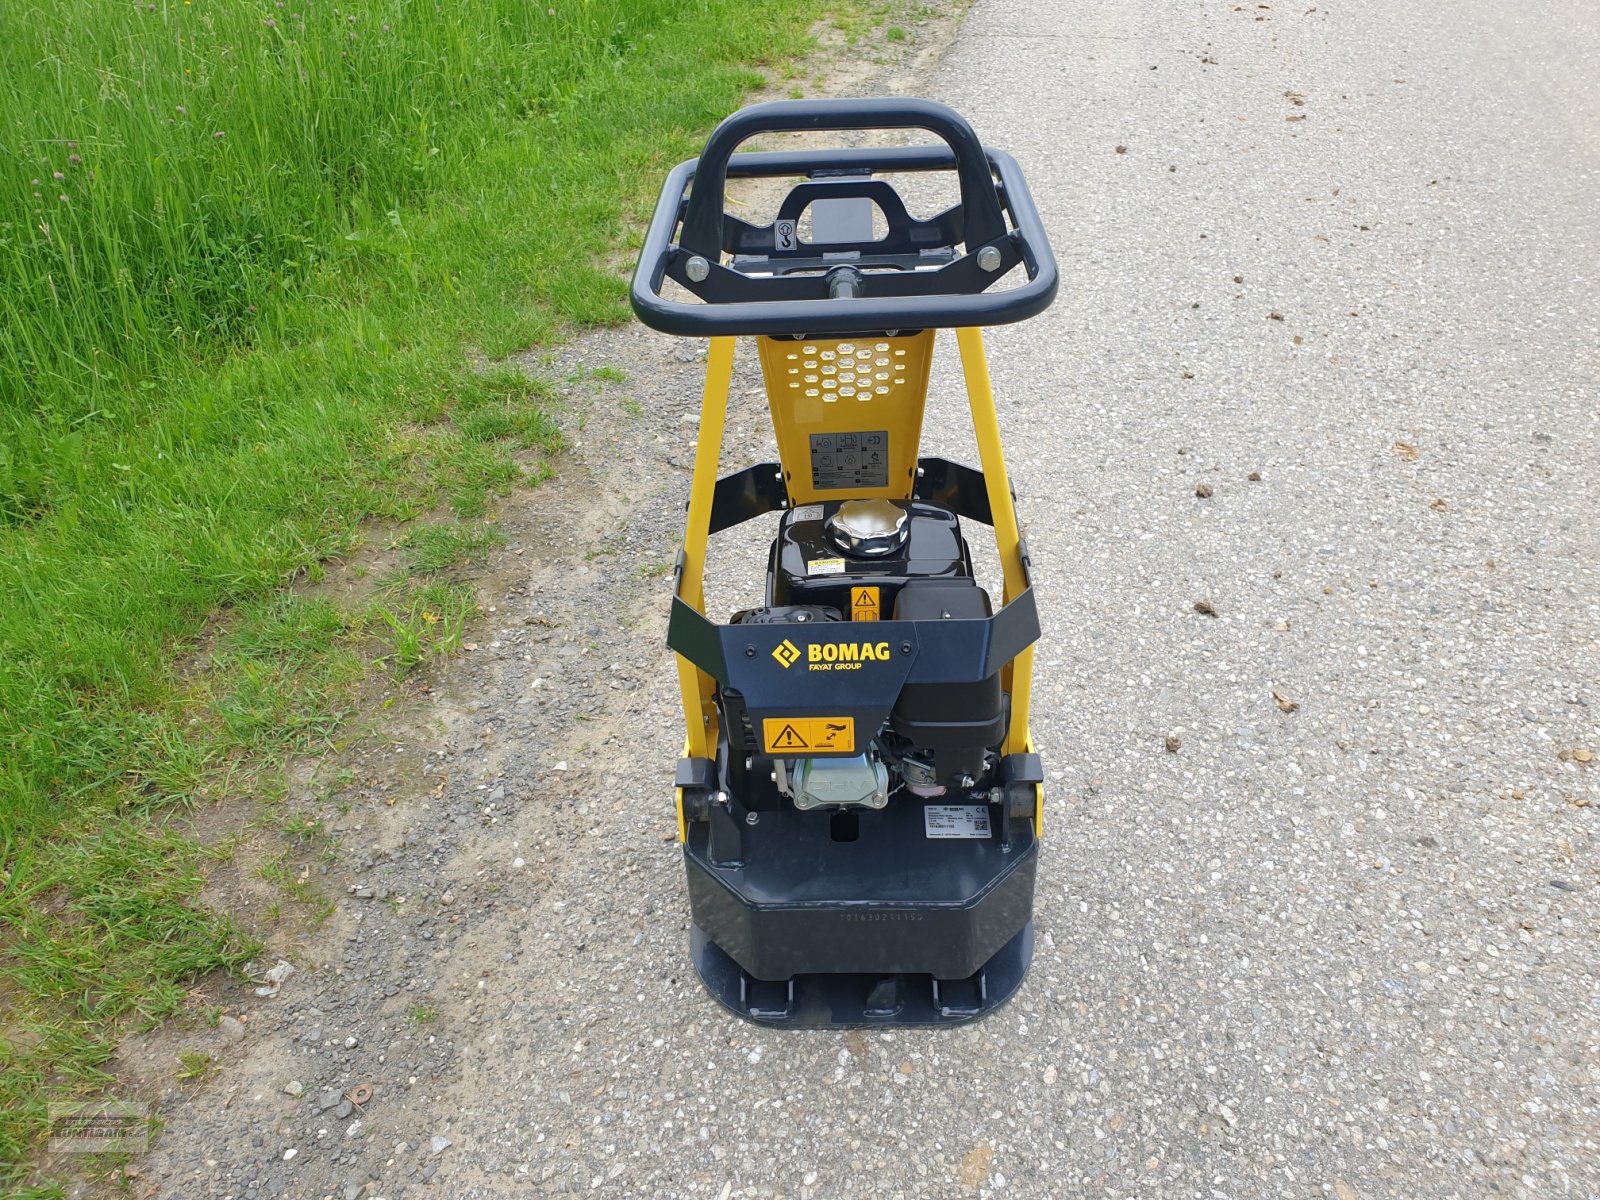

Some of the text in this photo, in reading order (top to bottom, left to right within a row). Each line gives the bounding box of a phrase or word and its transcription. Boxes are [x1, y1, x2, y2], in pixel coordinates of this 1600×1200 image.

[808, 642, 890, 662] BOMAG
[809, 662, 862, 671] FAYAT GROUP
